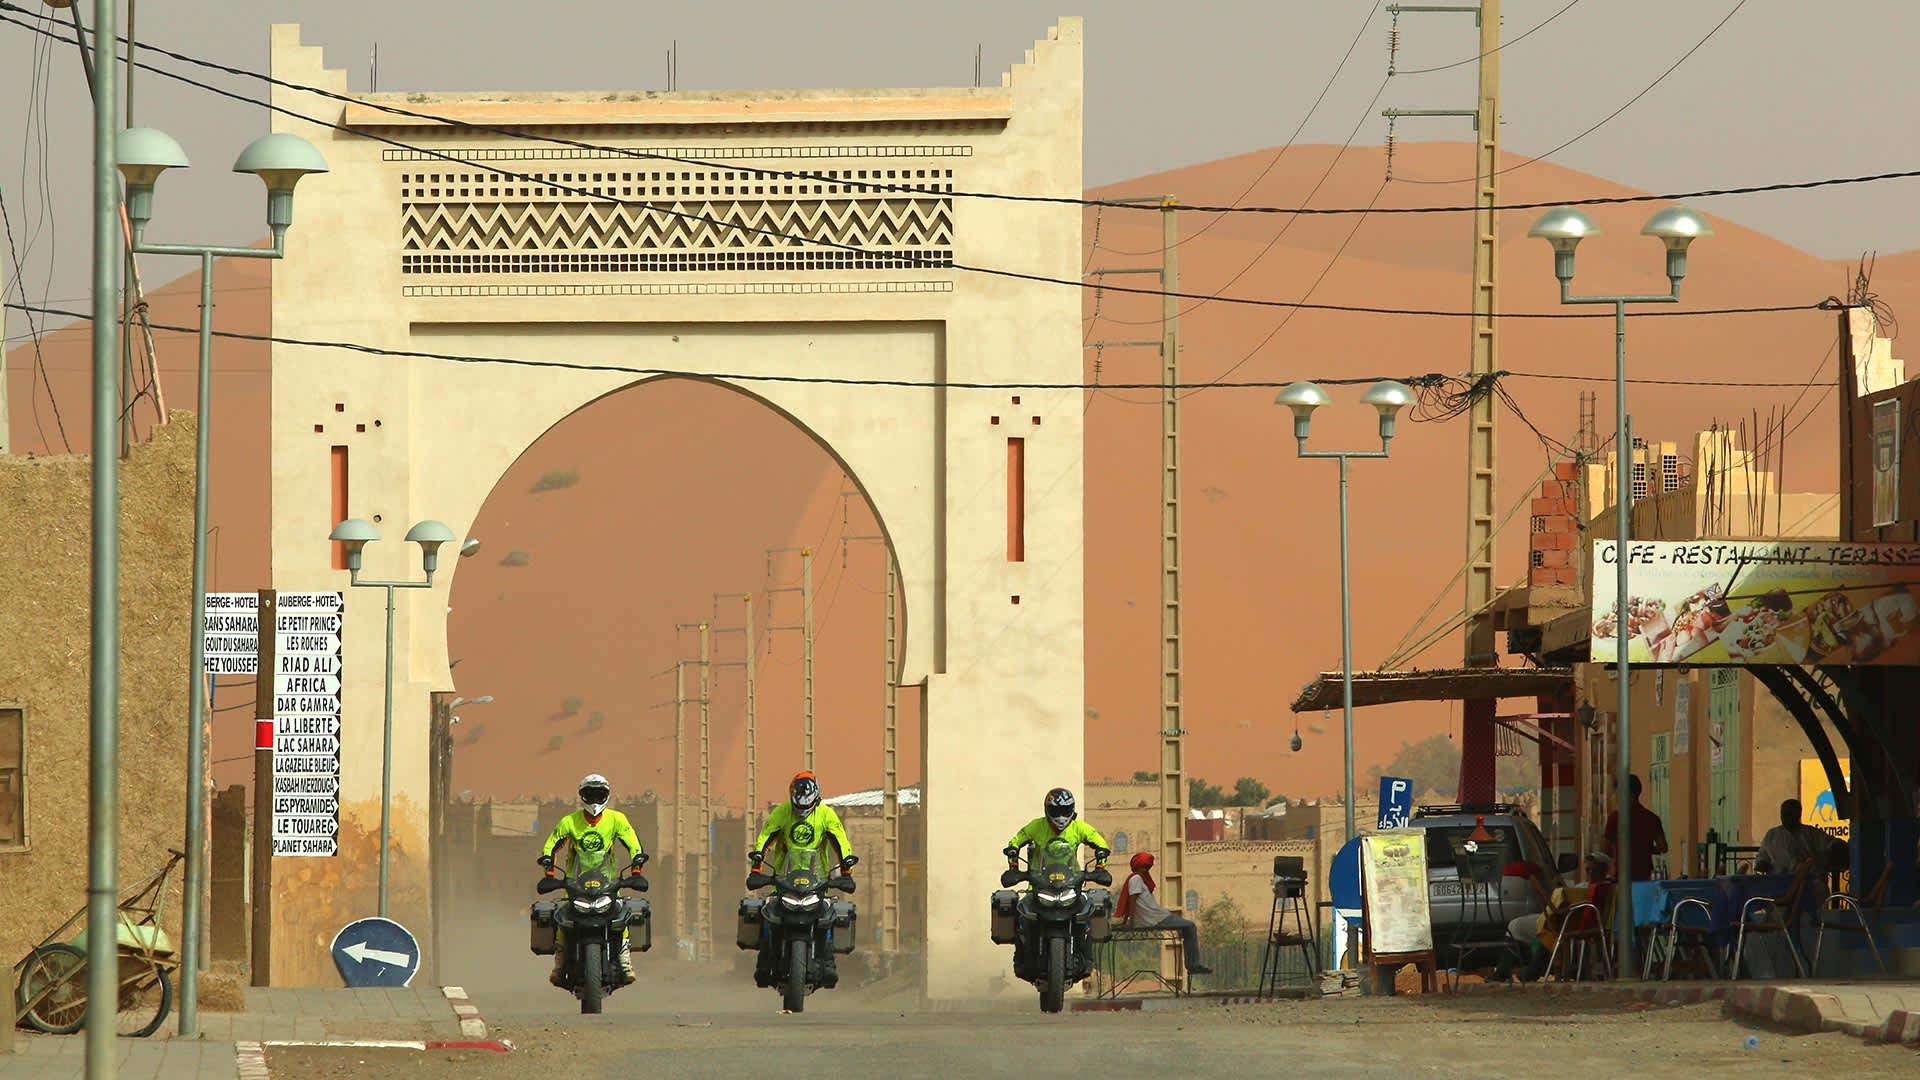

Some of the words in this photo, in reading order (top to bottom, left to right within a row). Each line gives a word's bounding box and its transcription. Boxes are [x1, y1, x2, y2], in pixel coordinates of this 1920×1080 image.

[1602, 545, 1655, 564] CFE
[206, 597, 258, 608] BERGE-HOTEL
[278, 595, 339, 607] AUBERGE-HOTEL
[204, 617, 224, 632] RANS
[225, 617, 258, 632] SAHARA
[278, 616, 287, 630] LE
[288, 616, 308, 630] PETIT
[310, 616, 336, 630] PRINCE
[205, 637, 222, 652] GOUT
[223, 637, 232, 652] DU
[233, 637, 258, 652] SAHARA
[286, 636, 299, 651] LES
[301, 636, 328, 651] ROCHES
[204, 657, 220, 672] HEZ
[221, 657, 258, 672] YOUSSEF
[282, 657, 310, 672] RIAD
[314, 657, 332, 672] ALI
[286, 678, 326, 692] AFRICA
[278, 698, 296, 712] DAR
[300, 698, 334, 712] GAMRA
[280, 718, 290, 733] LA
[294, 718, 332, 733] LIBERTE
[278, 738, 294, 752] LAC
[298, 738, 334, 752] SAHARA
[276, 758, 284, 772] LA
[285, 758, 313, 772] GAZELLE
[314, 758, 335, 772] BLEUE
[275, 777, 299, 792] KASBAH
[300, 777, 334, 792] MERZOUGA
[1391, 780, 1406, 804] P
[275, 798, 289, 813] LES
[290, 798, 334, 813] PYRAMIDES
[278, 819, 288, 834] LE
[292, 819, 334, 834] TOUAREG
[274, 840, 301, 852] PLANET
[302, 840, 332, 852] SAHARA
